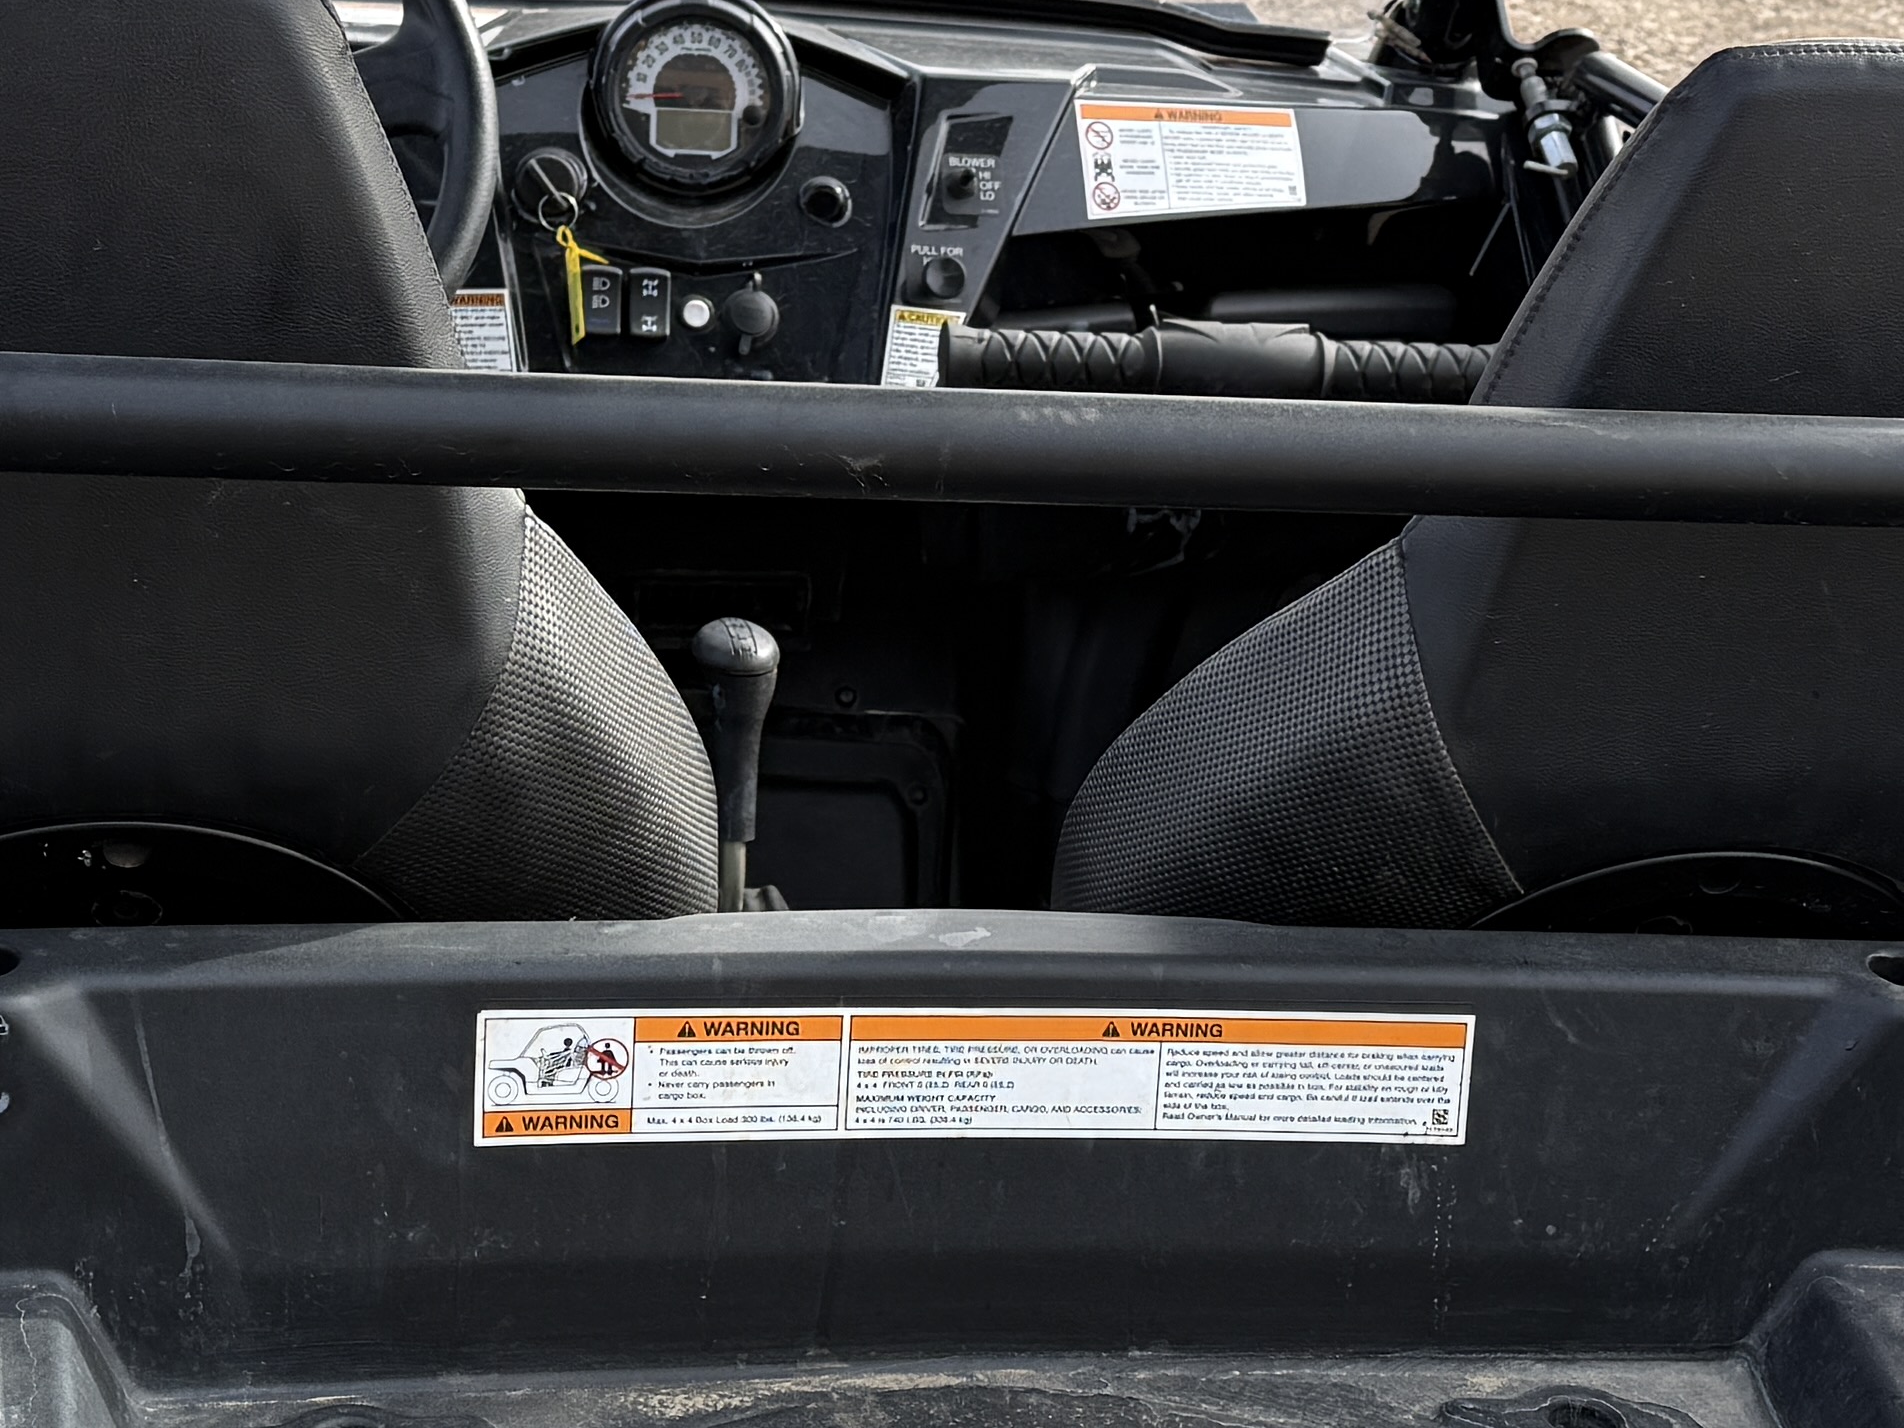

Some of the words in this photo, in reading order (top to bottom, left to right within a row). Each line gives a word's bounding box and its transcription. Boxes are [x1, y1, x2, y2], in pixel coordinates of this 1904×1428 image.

[724, 44, 737, 59] 70
[1166, 110, 1222, 121] WARNING
[949, 157, 995, 168] BLOWER
[980, 182, 1001, 190] OFF
[980, 192, 994, 201] LO
[911, 245, 938, 255] PULL
[941, 247, 962, 256] FOR
[704, 1021, 800, 1036] WARNING
[1130, 1021, 1223, 1038] WARNING
[660, 1058, 678, 1066] This
[522, 1115, 619, 1131] WARNING
